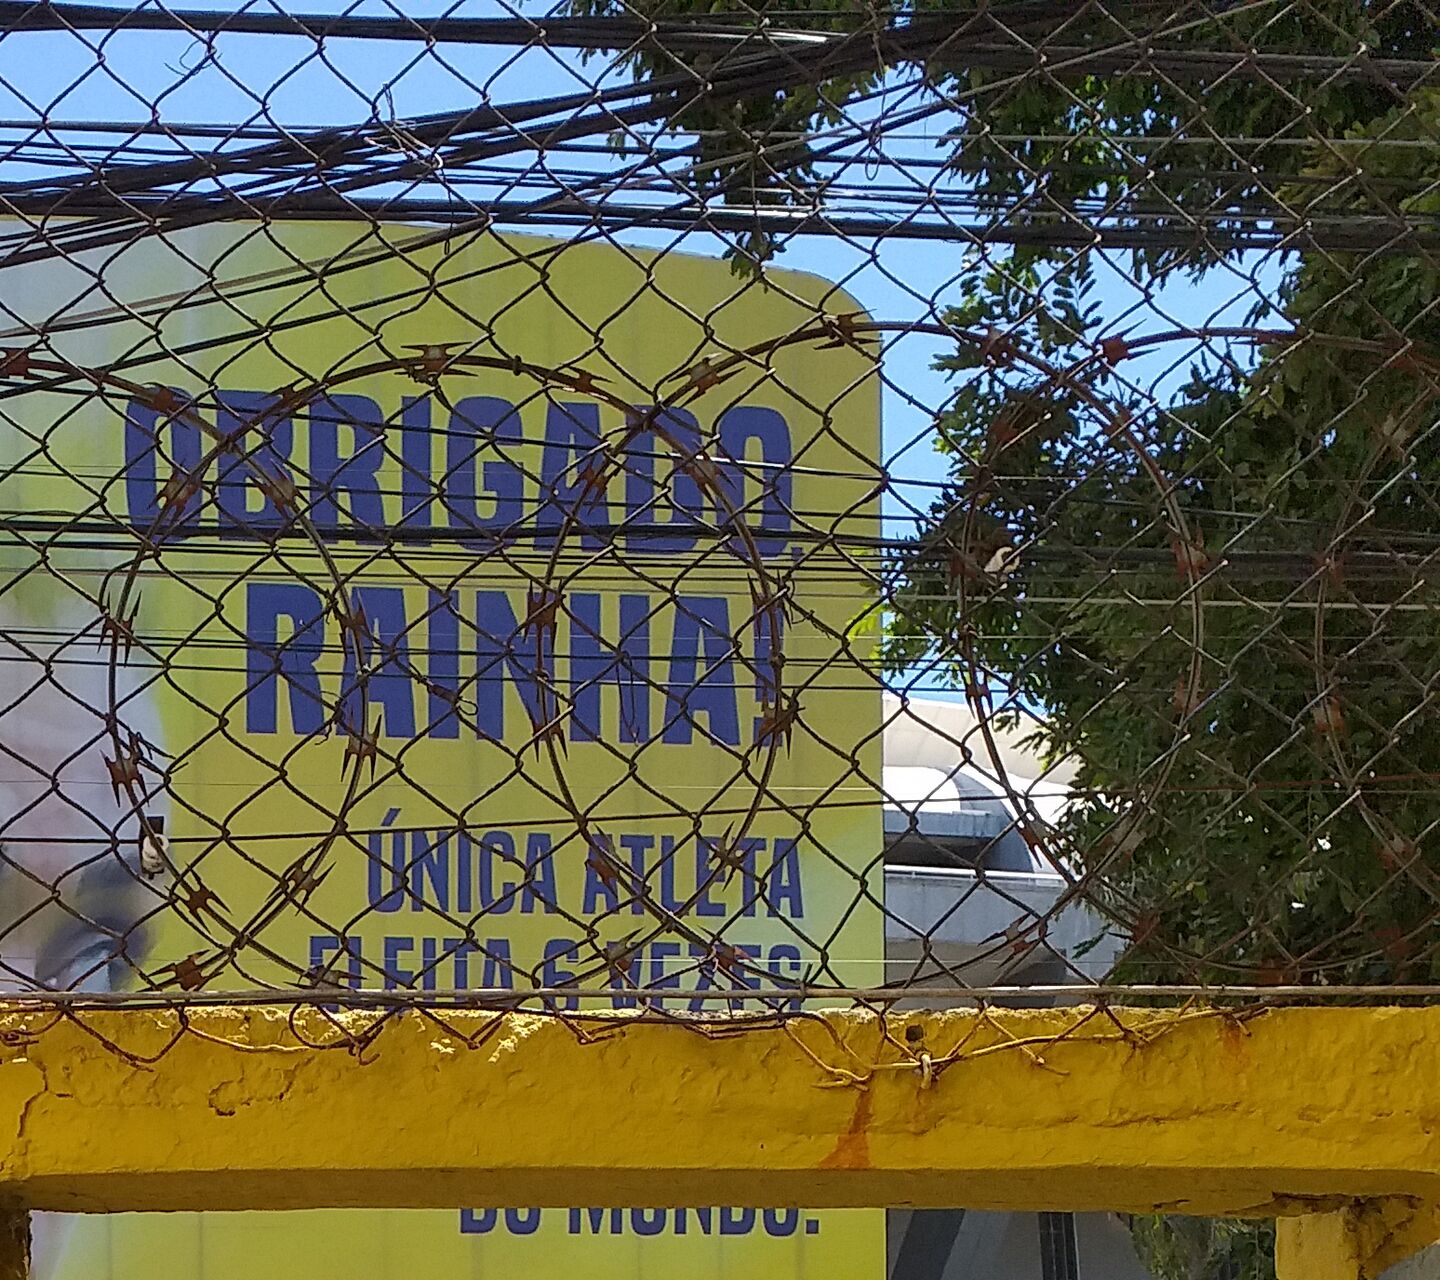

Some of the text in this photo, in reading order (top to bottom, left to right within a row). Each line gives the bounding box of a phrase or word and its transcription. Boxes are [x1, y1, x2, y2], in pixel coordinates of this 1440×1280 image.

[246, 583, 783, 747] RAINHA!
[368, 808, 804, 918] ÚNICA ATLETA
